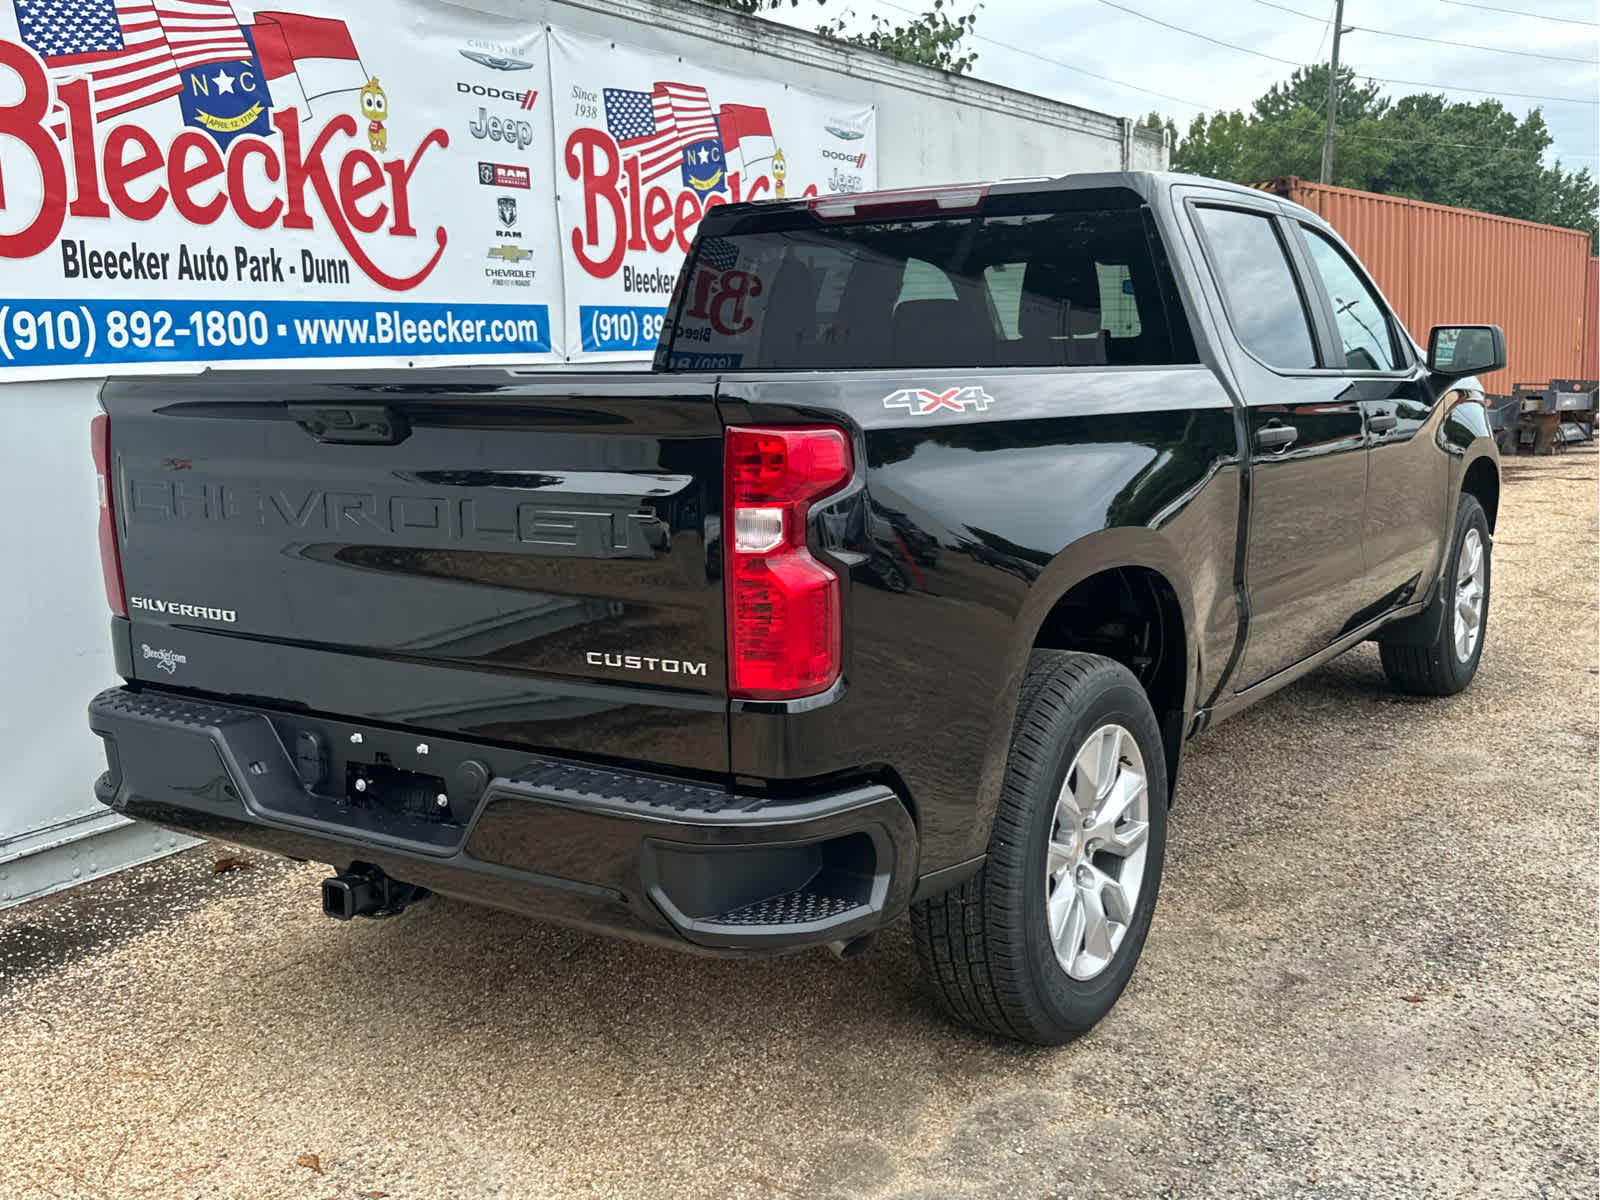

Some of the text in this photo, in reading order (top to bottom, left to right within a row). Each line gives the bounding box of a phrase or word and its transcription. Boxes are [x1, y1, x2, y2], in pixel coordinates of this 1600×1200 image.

[190, 71, 256, 96] N C
[457, 82, 526, 103] DODGE
[572, 85, 598, 102] Since
[575, 103, 598, 119] 1938
[470, 107, 533, 150] Jeep
[497, 167, 528, 180] RAM
[496, 229, 522, 239] RAM
[61, 239, 350, 284] Bleecker Auto Park Dunn
[485, 267, 537, 280] CHEVROLET
[623, 265, 675, 294] Bleecker
[0, 305, 538, 360] (910) 892-1800 www.Bleecker.com
[592, 311, 664, 346] (910) 89
[131, 596, 237, 623] SILVERADO
[586, 651, 707, 676] CUSTOM
